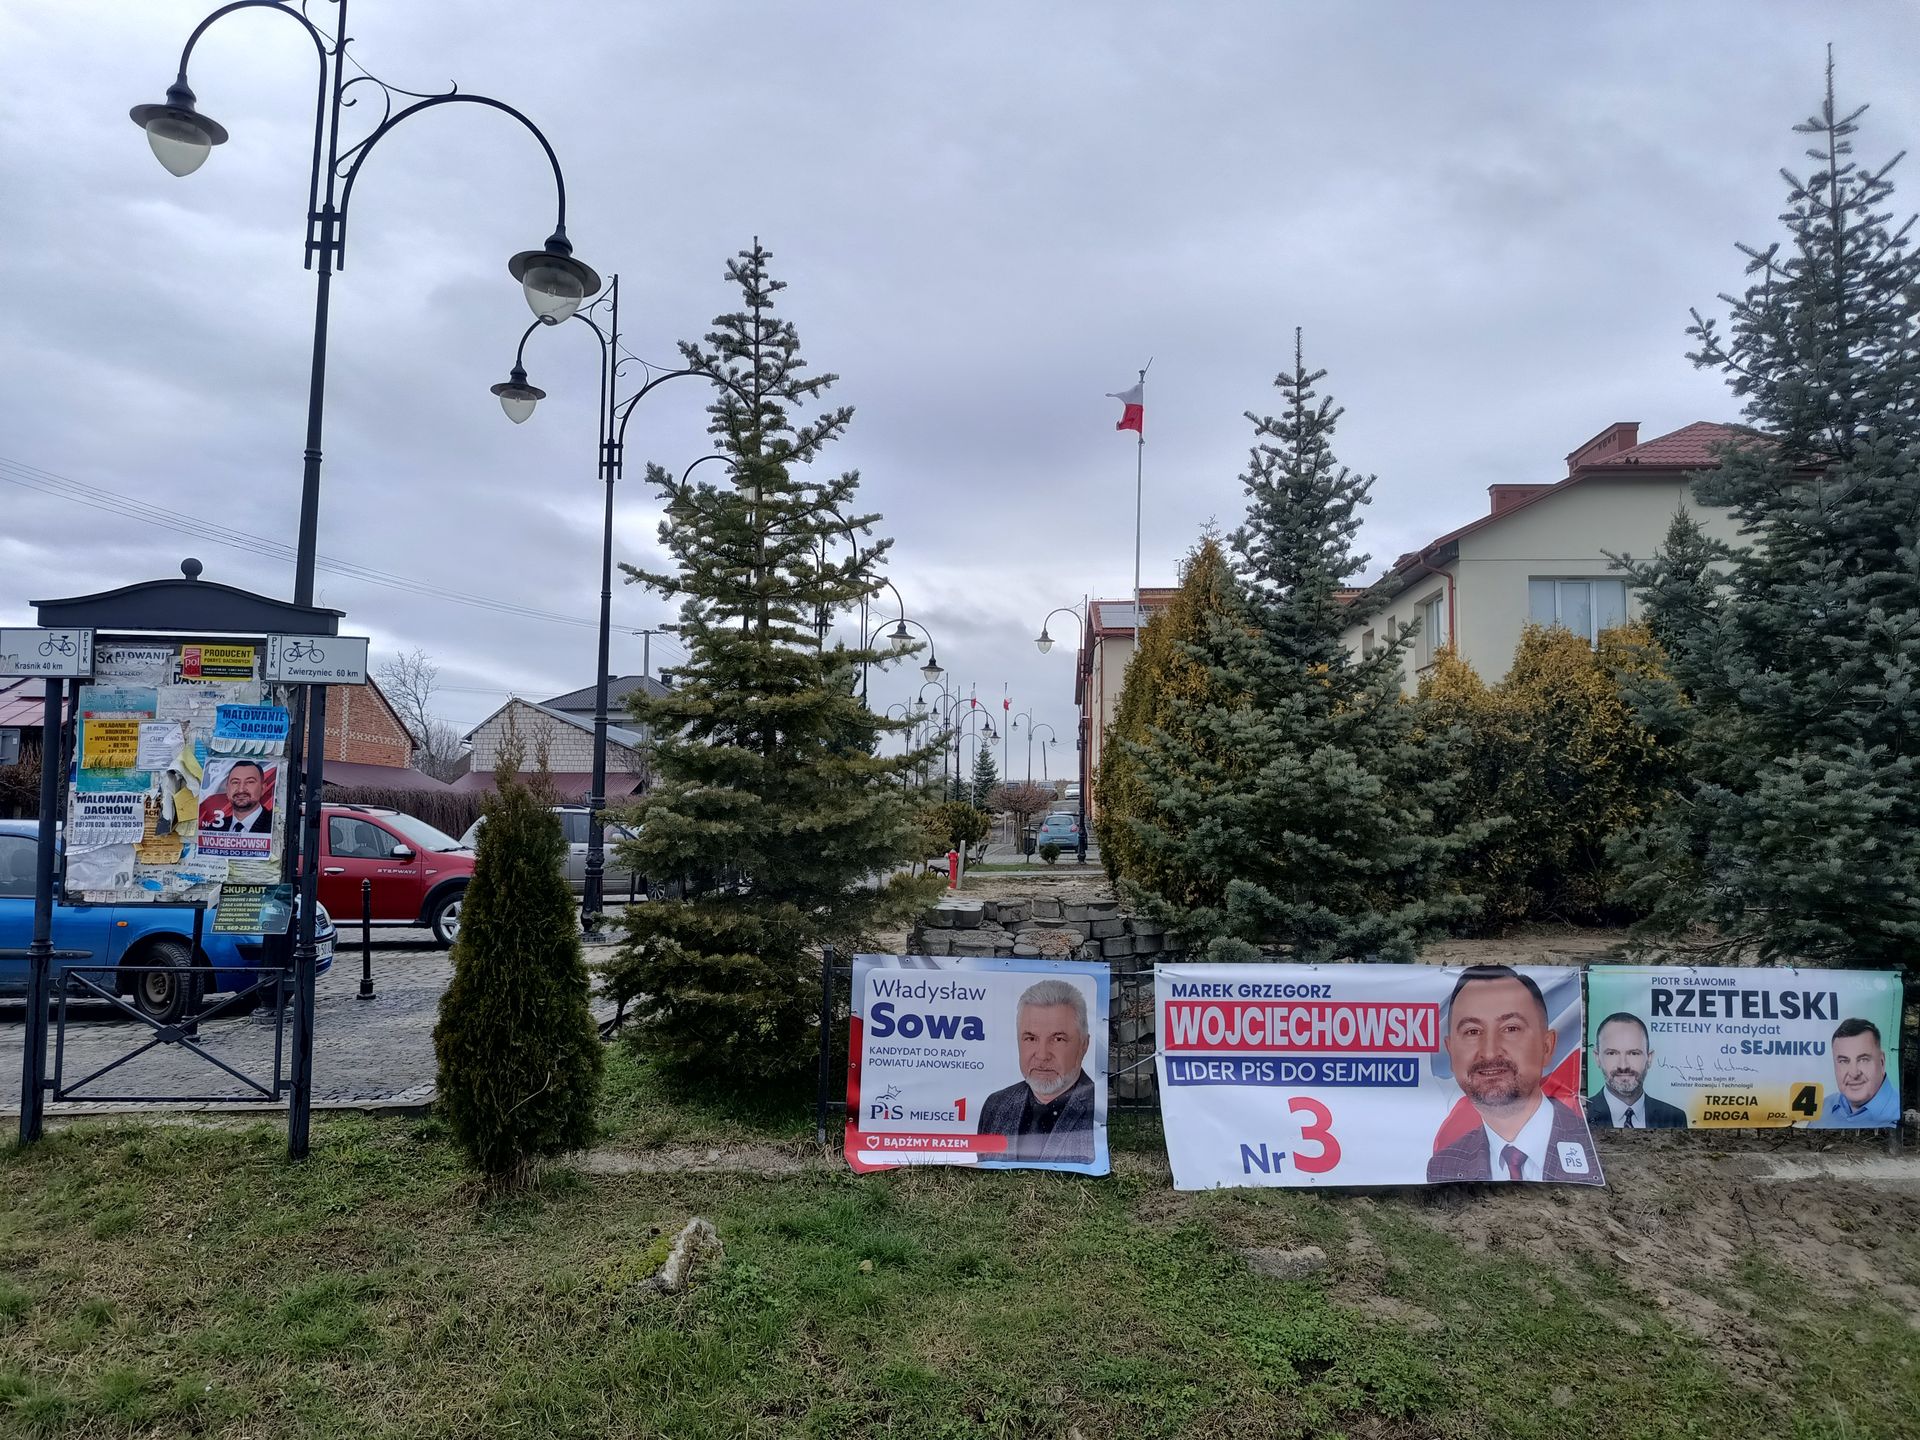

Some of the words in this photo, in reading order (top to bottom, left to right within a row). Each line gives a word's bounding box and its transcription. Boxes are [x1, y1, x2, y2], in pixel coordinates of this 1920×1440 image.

[204, 649, 252, 658] PRODUCENT
[15, 661, 41, 670] Kraśnik
[42, 662, 51, 670] 40
[52, 662, 63, 670] km
[288, 667, 332, 678] Zwierzyniec
[336, 669, 346, 678] 60
[347, 669, 358, 678] km
[223, 710, 284, 721] MALOWANIE
[241, 723, 283, 733] DACHÓW
[77, 795, 142, 804] MALOWANIE
[84, 805, 133, 815] DACHÓW
[212, 810, 225, 828] 3
[202, 836, 268, 848] WOJCIECHOWSKI
[223, 886, 246, 894] SKUP
[248, 886, 267, 894] AUT
[1651, 976, 1681, 987] PIOTR
[1683, 977, 1736, 987] SŁAWOMIR
[873, 979, 986, 1004] Władysław
[1171, 983, 1233, 998] MAREK
[1238, 984, 1331, 999] GRZEGORZ
[1651, 988, 1839, 1021] RZETELSKI
[871, 1002, 985, 1041] Sowa
[1170, 1006, 1436, 1047] WOJCIECHOWSKI
[1651, 1022, 1711, 1034] RZETELNY
[1716, 1024, 1781, 1038] Kandydat
[869, 1047, 921, 1056] KANDYDAT
[924, 1048, 938, 1056] DO
[940, 1049, 967, 1057] RADY
[1721, 1043, 1737, 1055] do
[1741, 1040, 1826, 1056] SEJMIKU
[869, 1058, 913, 1067] POWIATU
[916, 1060, 984, 1070] JANOWSKIEGO
[1173, 1061, 1235, 1081] LIDER
[1242, 1062, 1275, 1081] PiS
[1280, 1063, 1317, 1081] DO
[1322, 1063, 1415, 1082] SEJMIKU
[1703, 1110, 1749, 1121] DROGA
[1767, 1111, 1788, 1121] poz.
[1791, 1085, 1818, 1116] 4
[1705, 1095, 1758, 1106] TRZECIA
[870, 1104, 903, 1120] PiS
[910, 1111, 955, 1122] MIEJSCE
[954, 1098, 967, 1122] 1
[884, 1135, 928, 1149] BĄDŹMY
[931, 1138, 968, 1148] RAZEM
[1240, 1144, 1285, 1174] Nr
[1288, 1097, 1342, 1174] 3
